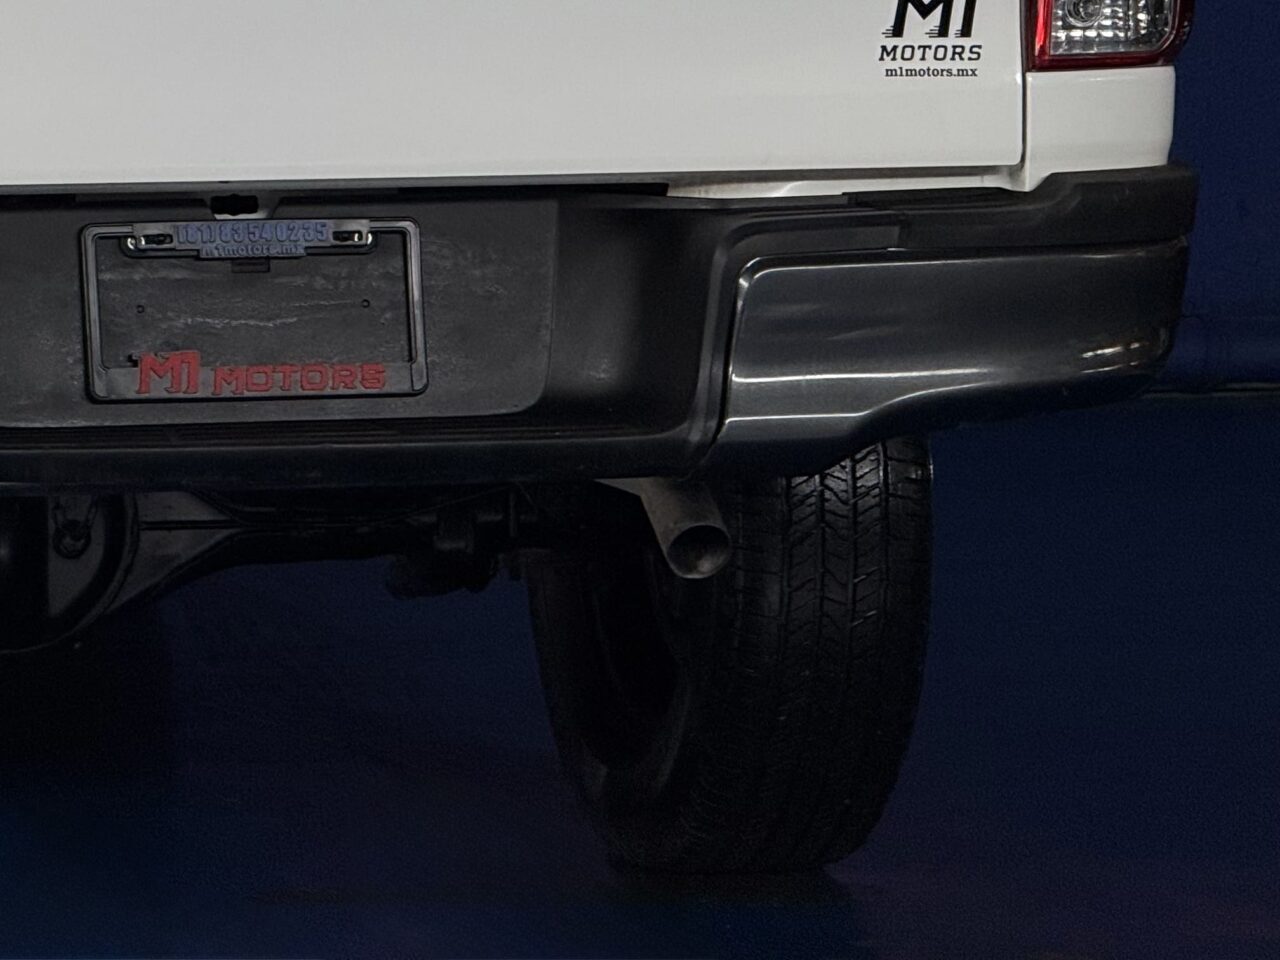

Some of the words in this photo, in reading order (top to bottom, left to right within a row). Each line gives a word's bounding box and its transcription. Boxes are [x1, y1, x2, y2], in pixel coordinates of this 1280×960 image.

[878, 44, 983, 62] MOTORS
[885, 66, 979, 77] m1motors.mx
[136, 351, 201, 395] M1
[211, 362, 387, 396] MOTORS
